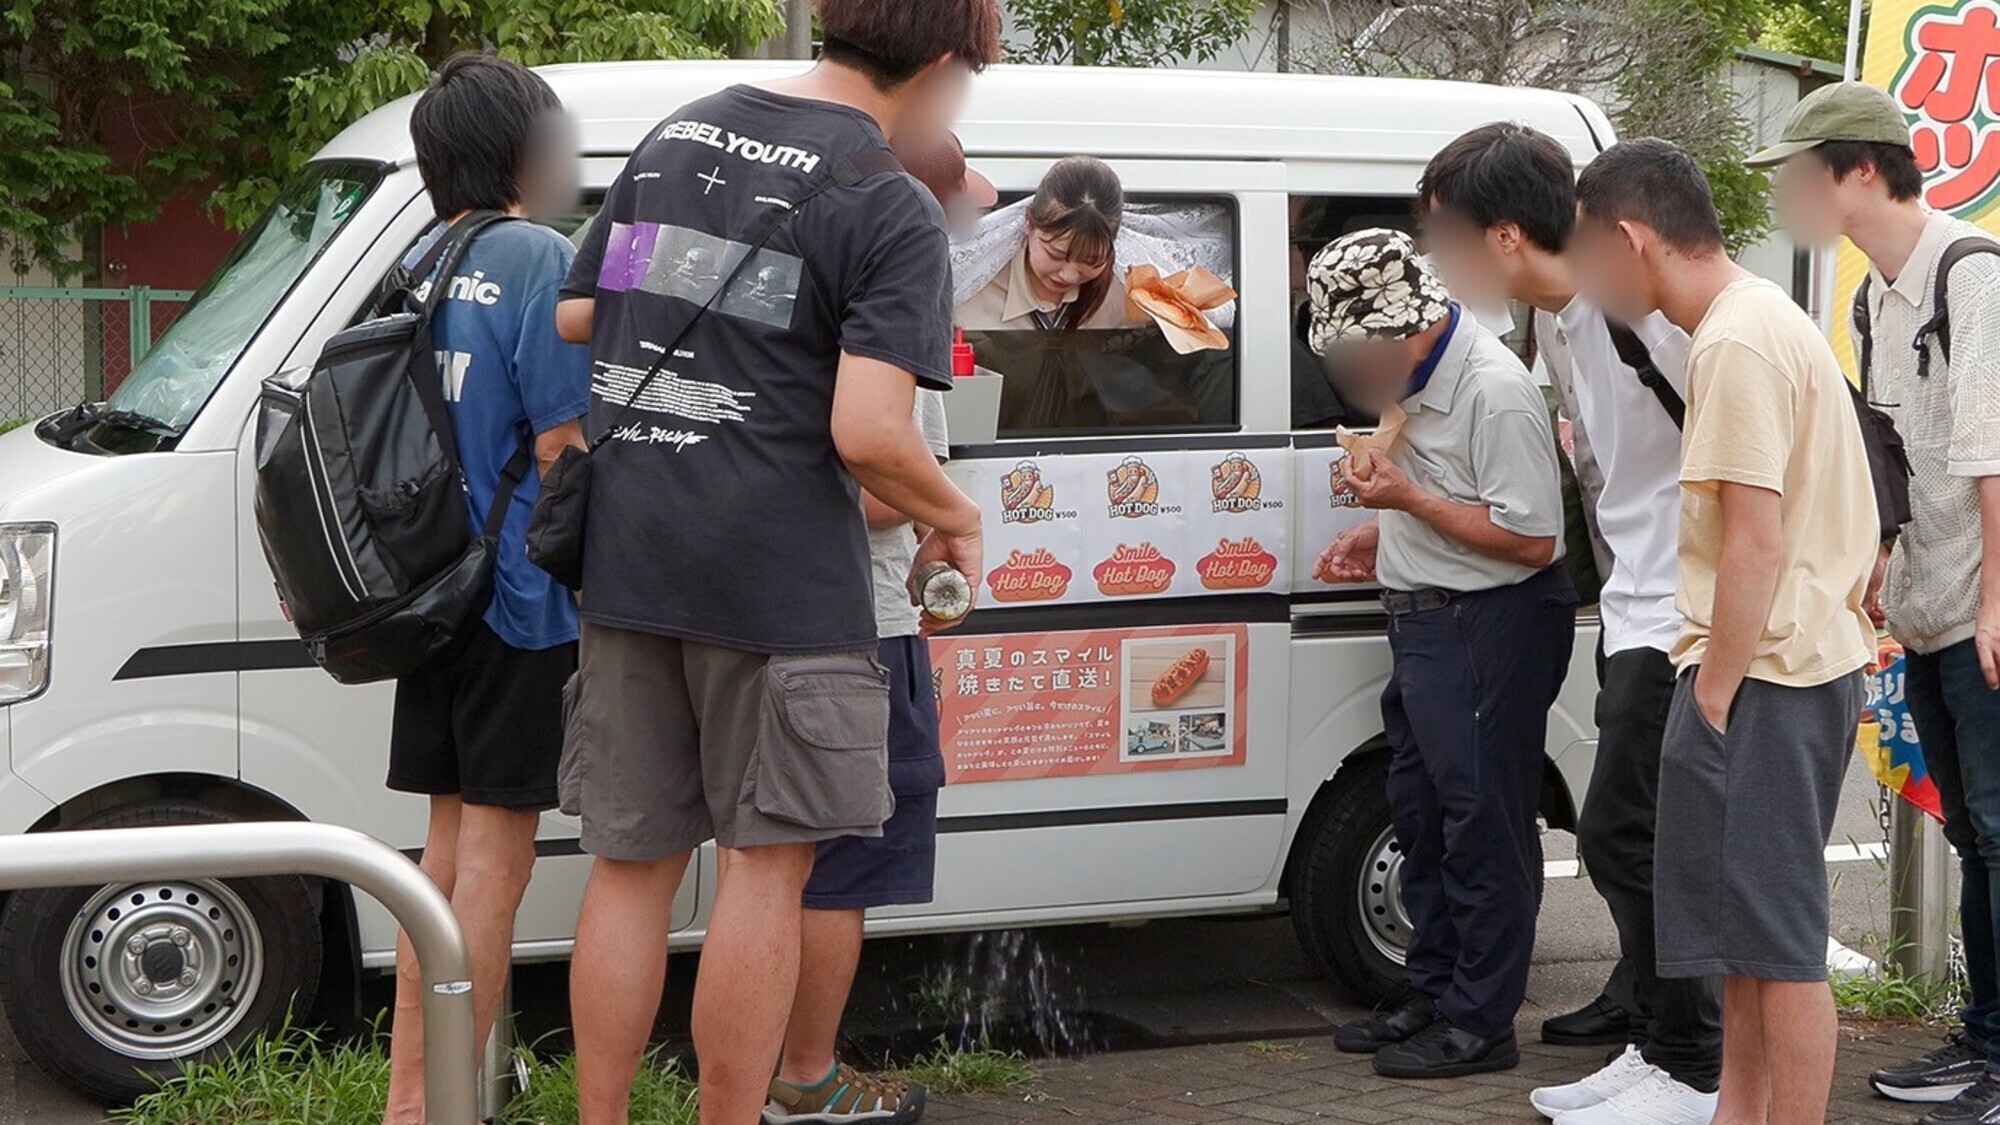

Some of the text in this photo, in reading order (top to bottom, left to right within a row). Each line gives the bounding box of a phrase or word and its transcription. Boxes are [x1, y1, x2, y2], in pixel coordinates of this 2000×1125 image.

[1108, 503, 1182, 518] HOT DOG ¥500
[1212, 498, 1284, 513] HOT DOG ¥500
[1330, 495, 1355, 508] HOT
[1002, 508, 1078, 524] HOT DOG ¥500
[1114, 542, 1159, 562] Smile
[1217, 537, 1261, 557] Smile
[1008, 547, 1054, 568] Smile
[1102, 565, 1170, 587] Hot Dog
[1205, 559, 1270, 581] Hot Dog
[996, 571, 1064, 592] Hot Dog
[956, 646, 1113, 670] 真夏のスマイル
[957, 667, 1111, 696] 焼きたて直送!
